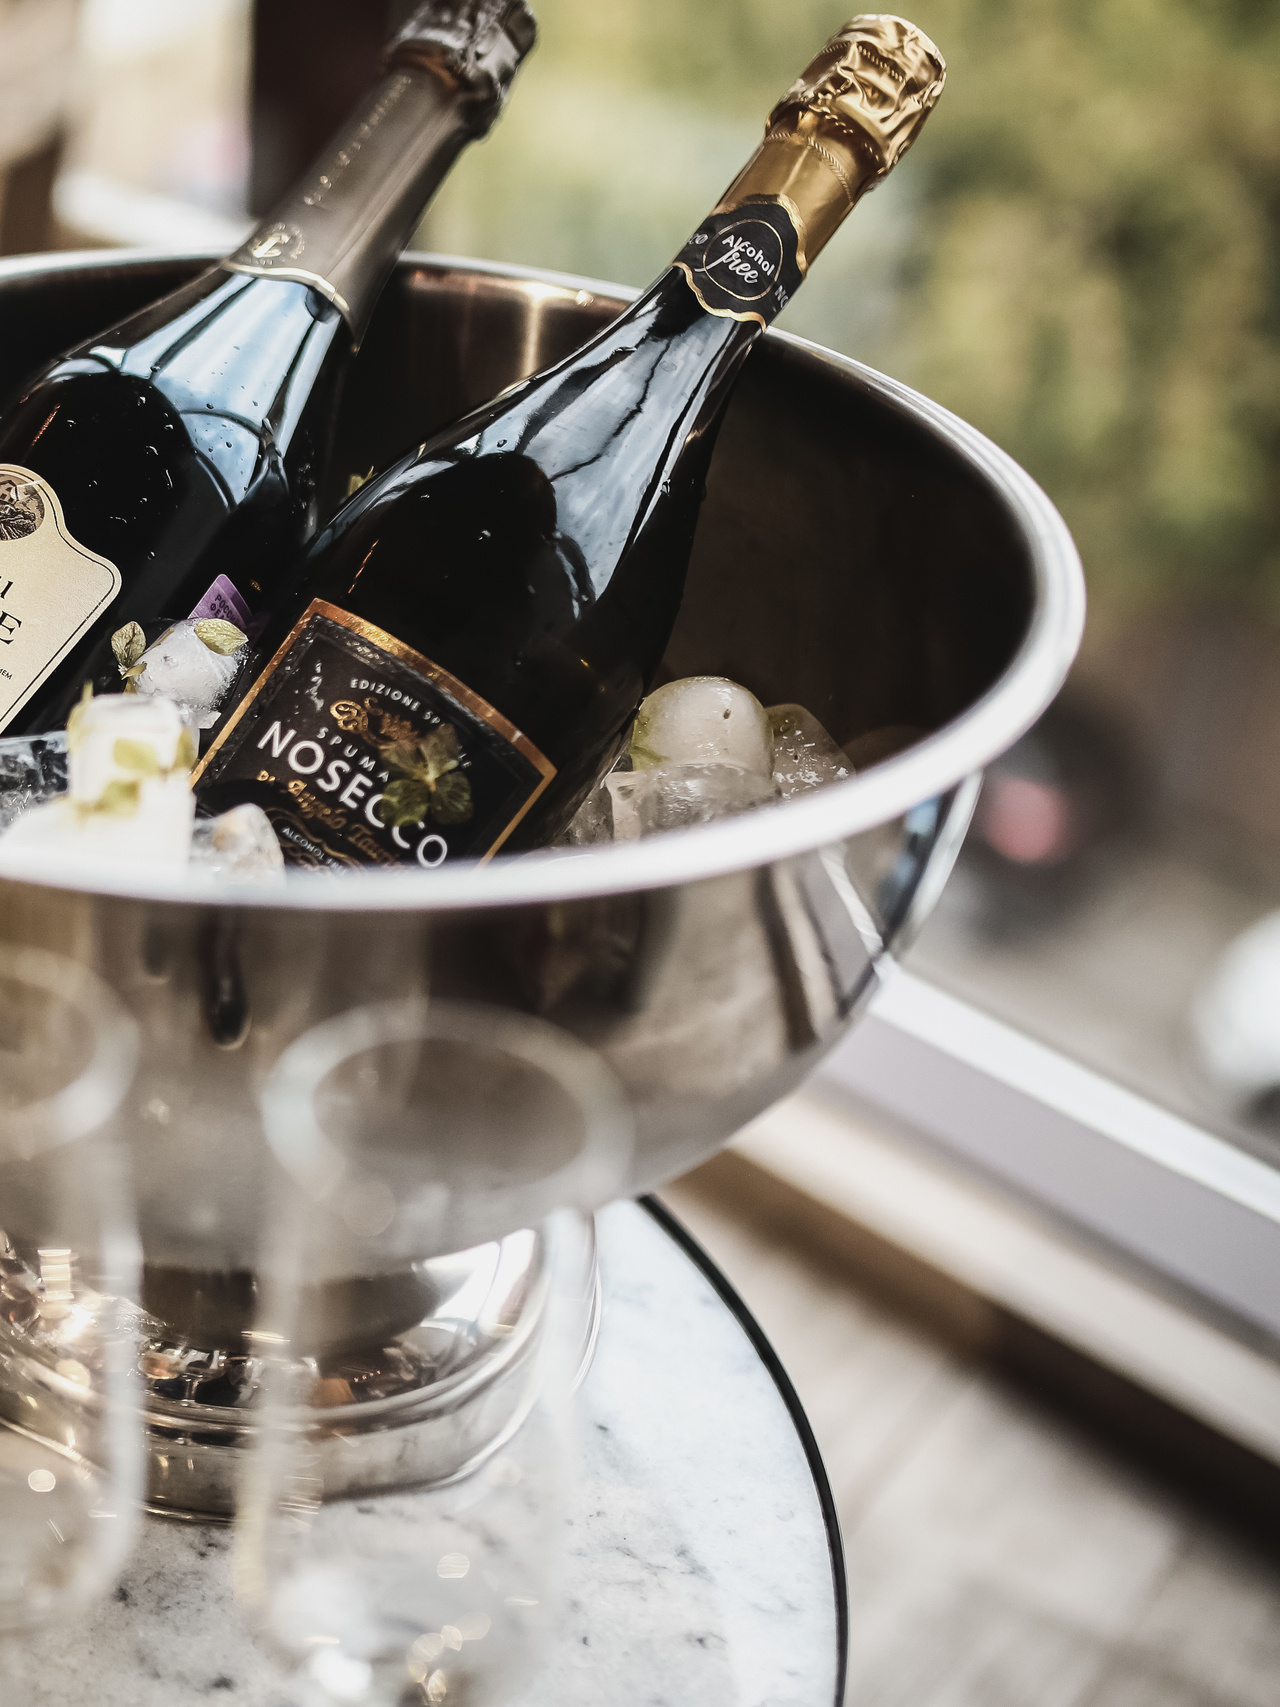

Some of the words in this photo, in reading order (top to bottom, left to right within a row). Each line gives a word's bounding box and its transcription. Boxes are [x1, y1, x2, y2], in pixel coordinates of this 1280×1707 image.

[694, 241, 758, 284] free
[722, 235, 775, 276] Alcohol
[350, 679, 420, 711] EDIZIONE
[257, 720, 448, 867] NOSECCO
[282, 827, 325, 860] ALCOHOL
